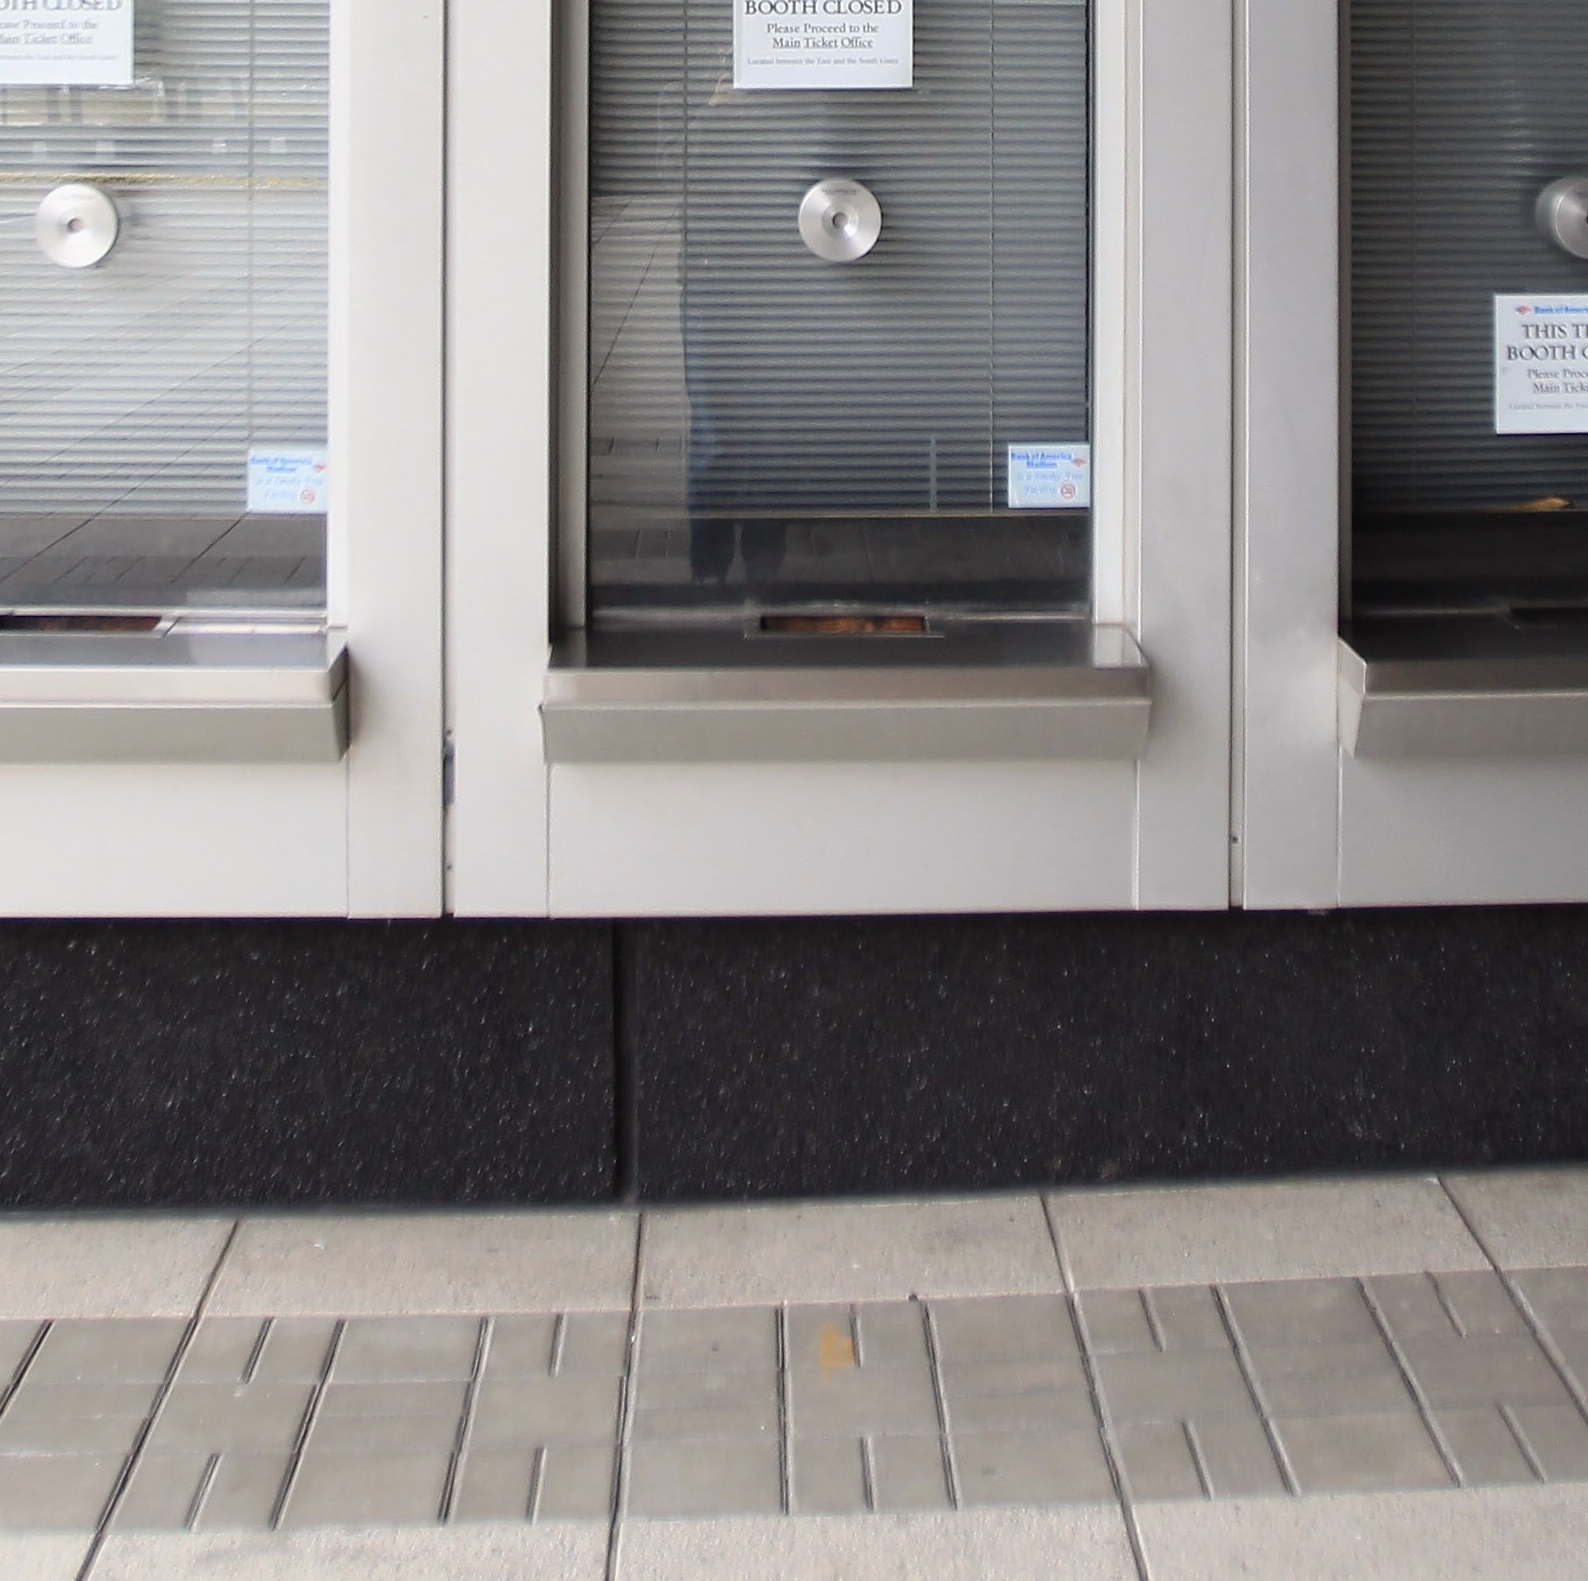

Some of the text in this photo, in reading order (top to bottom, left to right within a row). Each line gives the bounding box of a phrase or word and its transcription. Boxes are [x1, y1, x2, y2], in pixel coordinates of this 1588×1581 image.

[745, 0, 902, 14] BOOTH CLOSED
[767, 23, 879, 33] Please Proceed to the
[773, 37, 873, 48] Main Ticket Office
[1522, 324, 1567, 338] THIS
[1507, 345, 1575, 360] BOOTH
[1528, 369, 1559, 379] Please
[1533, 383, 1560, 393] Main
